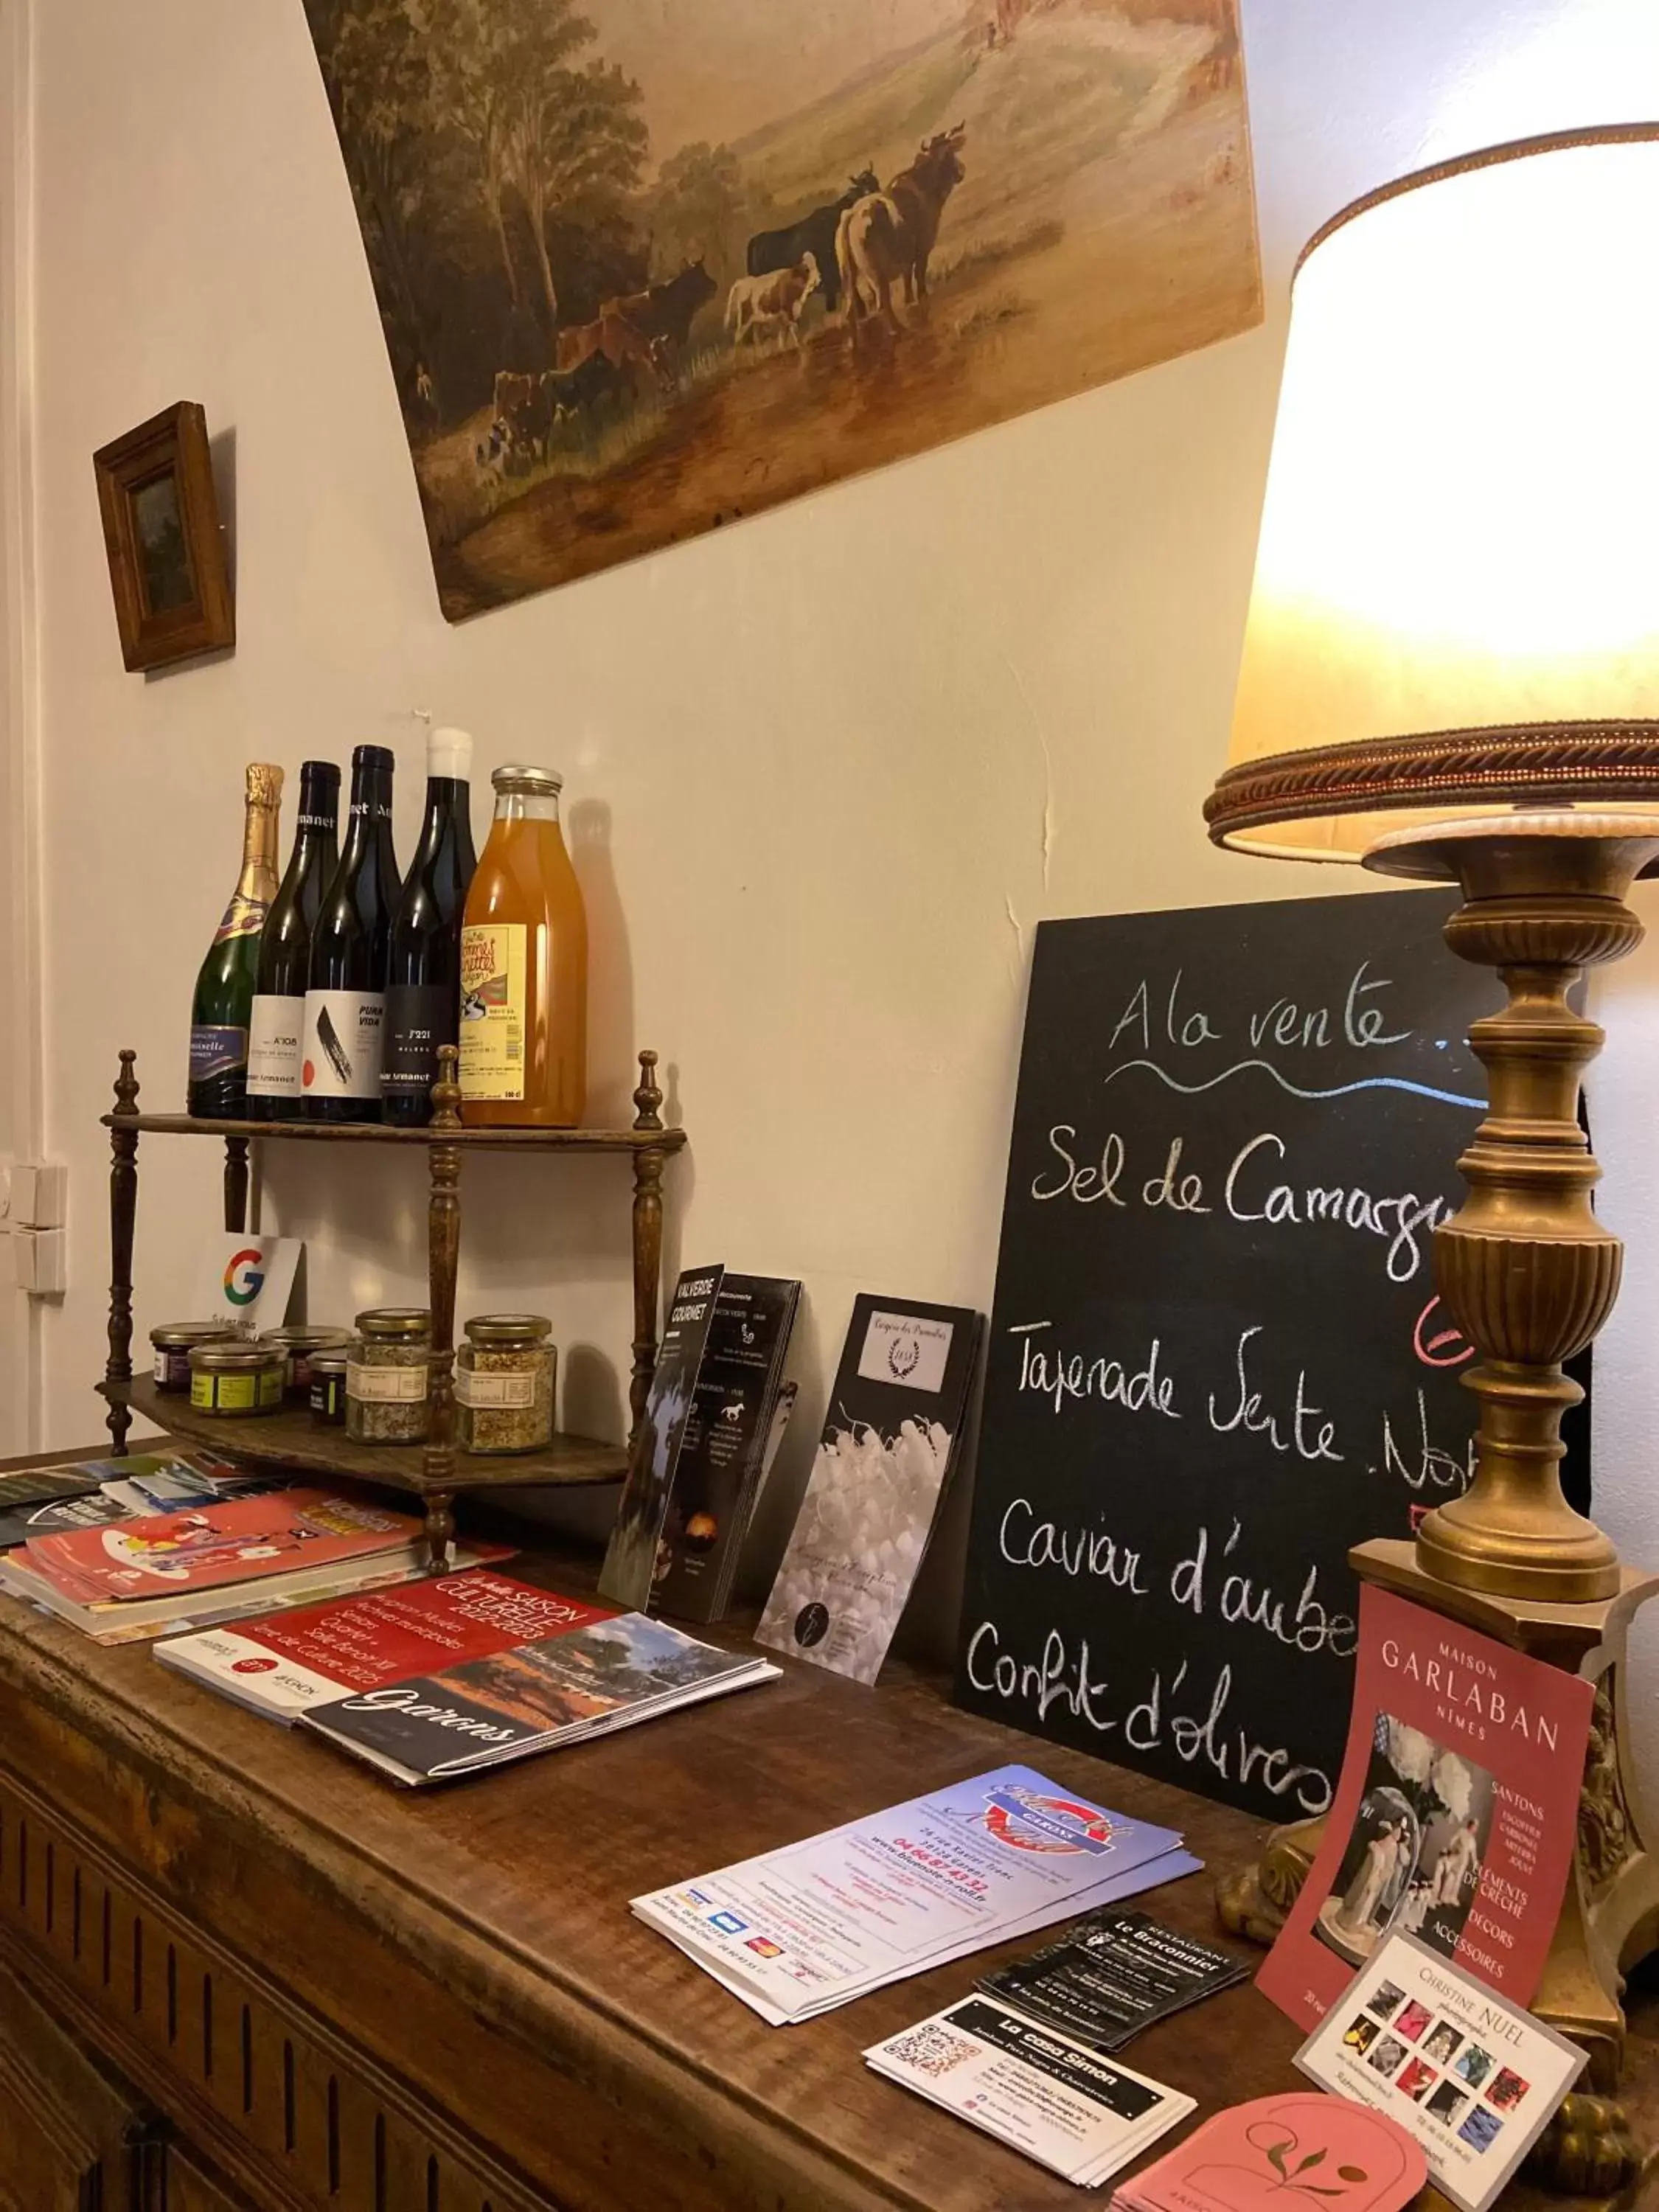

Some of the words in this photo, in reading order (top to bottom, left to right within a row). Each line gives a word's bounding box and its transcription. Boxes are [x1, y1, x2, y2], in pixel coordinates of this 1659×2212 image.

[1108, 979, 1150, 1049] A
[1167, 967, 1222, 1046] la
[1251, 960, 1412, 1048] vente
[1032, 1124, 1127, 1206] Sel
[1143, 1136, 1213, 1214] de
[1226, 1133, 1457, 1283] Camargu
[672, 1303, 707, 1323] GOURMET
[1000, 1498, 1149, 1594] Caviar
[436, 1582, 563, 1630] CULTURELLE
[506, 1591, 588, 1622] SAISON
[1439, 1641, 1499, 1681] MAISON
[341, 1688, 514, 1742] Garons
[1381, 1640, 1561, 1753] GARLABAN
[1491, 1780, 1545, 1822] SANTONS
[889, 1837, 917, 1850] 04
[908, 1847, 936, 1861] 66
[925, 1857, 953, 1871] 87
[945, 1868, 973, 1881] 43
[964, 1878, 992, 1893] 32
[1464, 1871, 1478, 1889] DE
[1111, 1920, 1138, 1933] Le
[1130, 1927, 1221, 1975] Braconnier
[1147, 1925, 1231, 1965] RESTAURANT
[1433, 1920, 1506, 1980] ACCESSOIRES
[1418, 1966, 1476, 2013] CHRISTINE
[1478, 2006, 1526, 2048] NUEL
[996, 2018, 1026, 2035] La
[1020, 2031, 1067, 2057] casa
[1059, 2051, 1123, 2086] Simon
